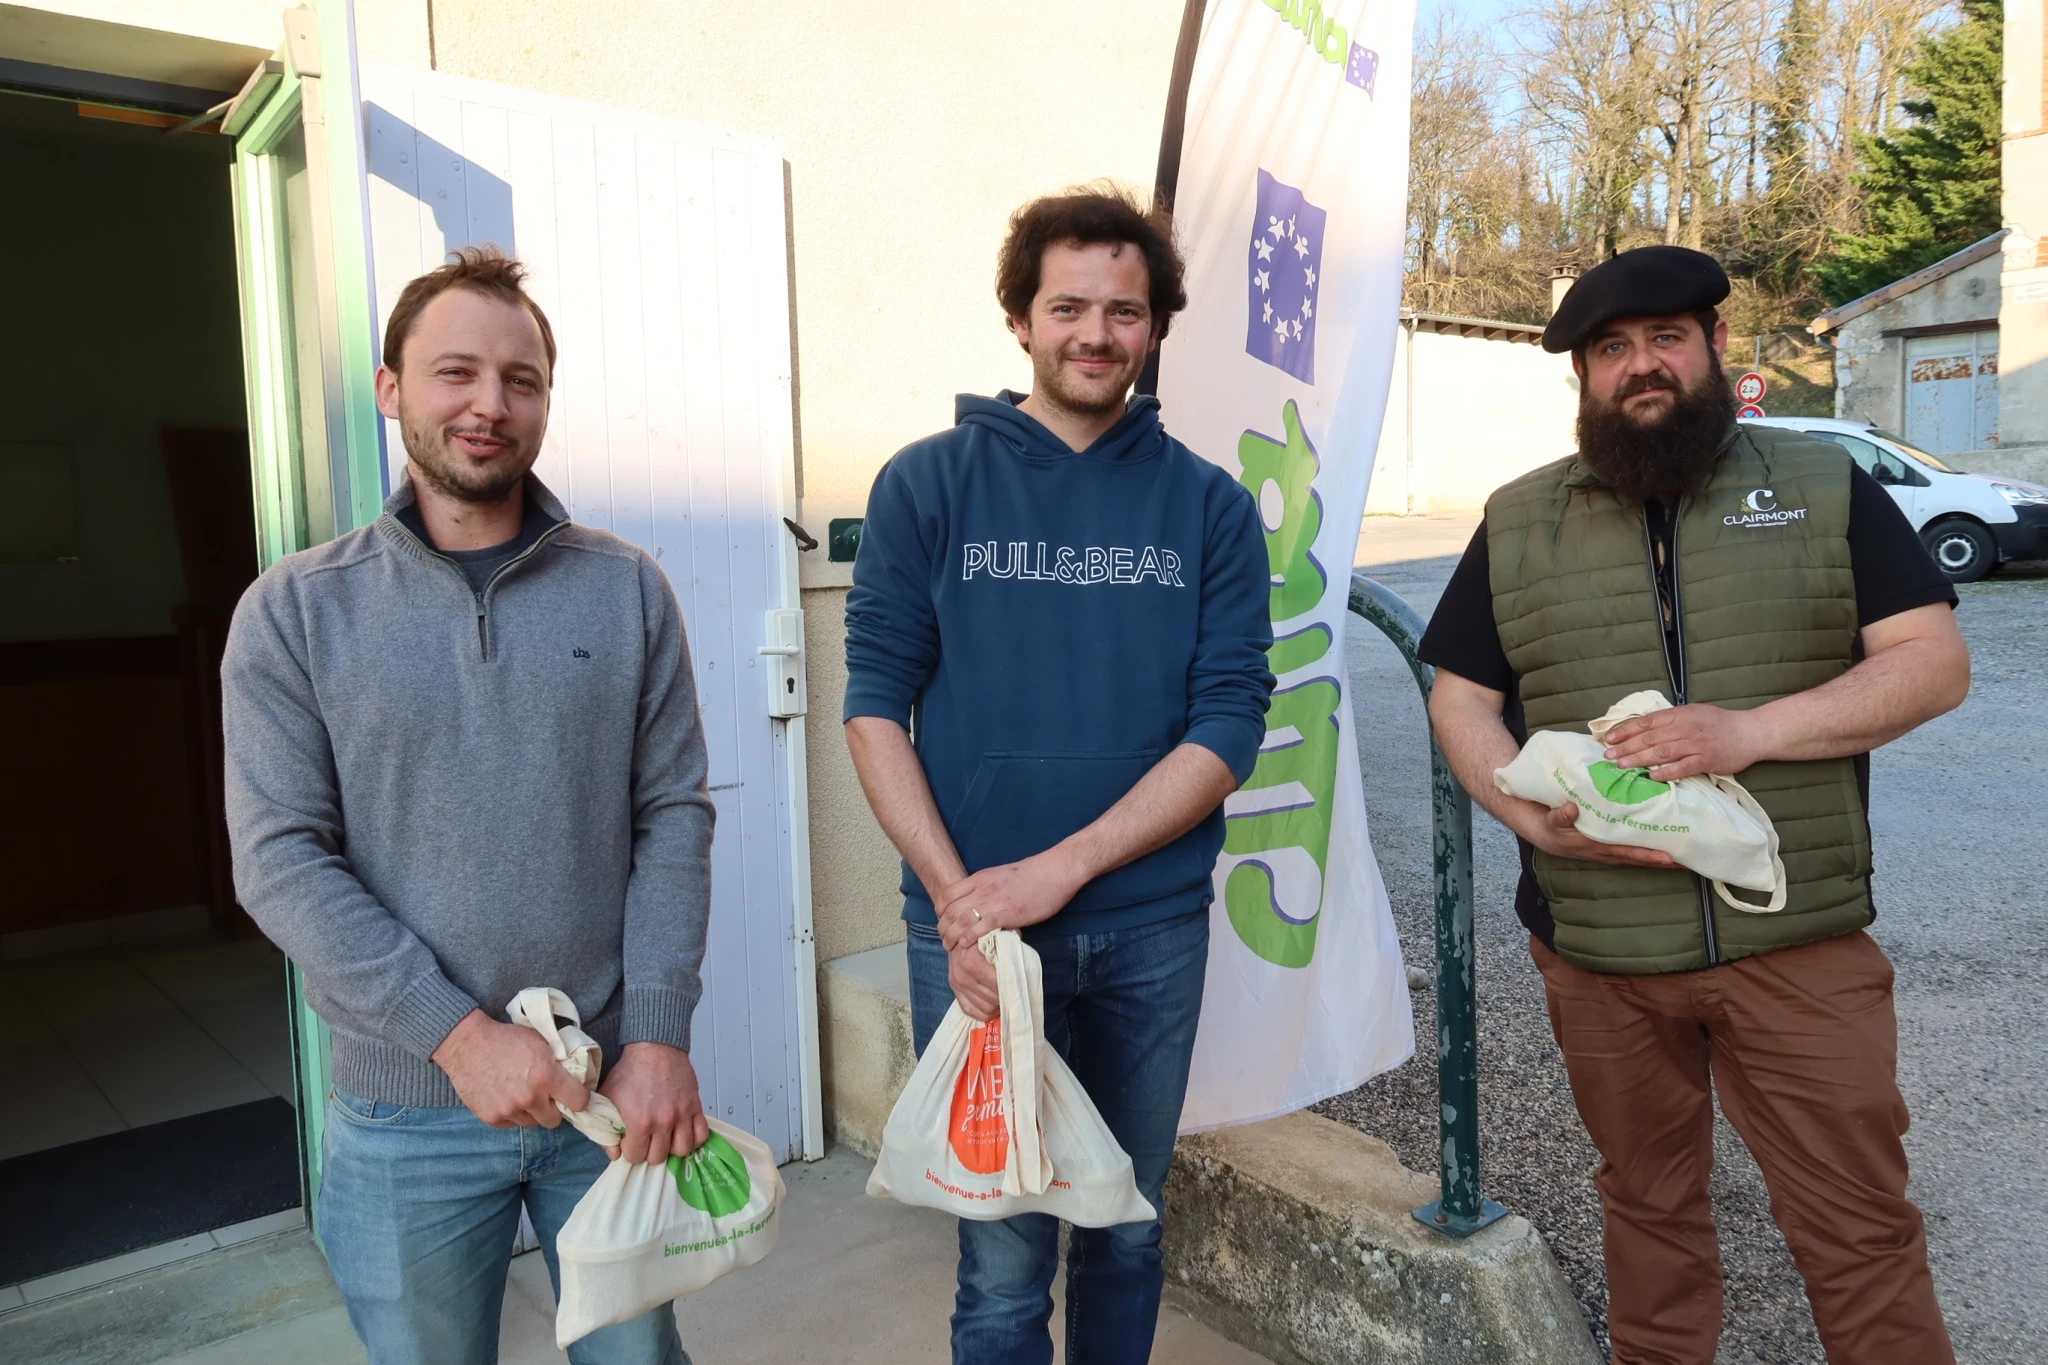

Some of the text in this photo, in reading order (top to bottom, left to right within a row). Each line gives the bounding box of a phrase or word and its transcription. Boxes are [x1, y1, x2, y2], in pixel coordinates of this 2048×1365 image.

[1723, 508, 1808, 526] CLAIRMONT
[962, 540, 1186, 588] PULL&BEAR
[1553, 767, 1690, 833] bienvenue-a-la-ferme.com
